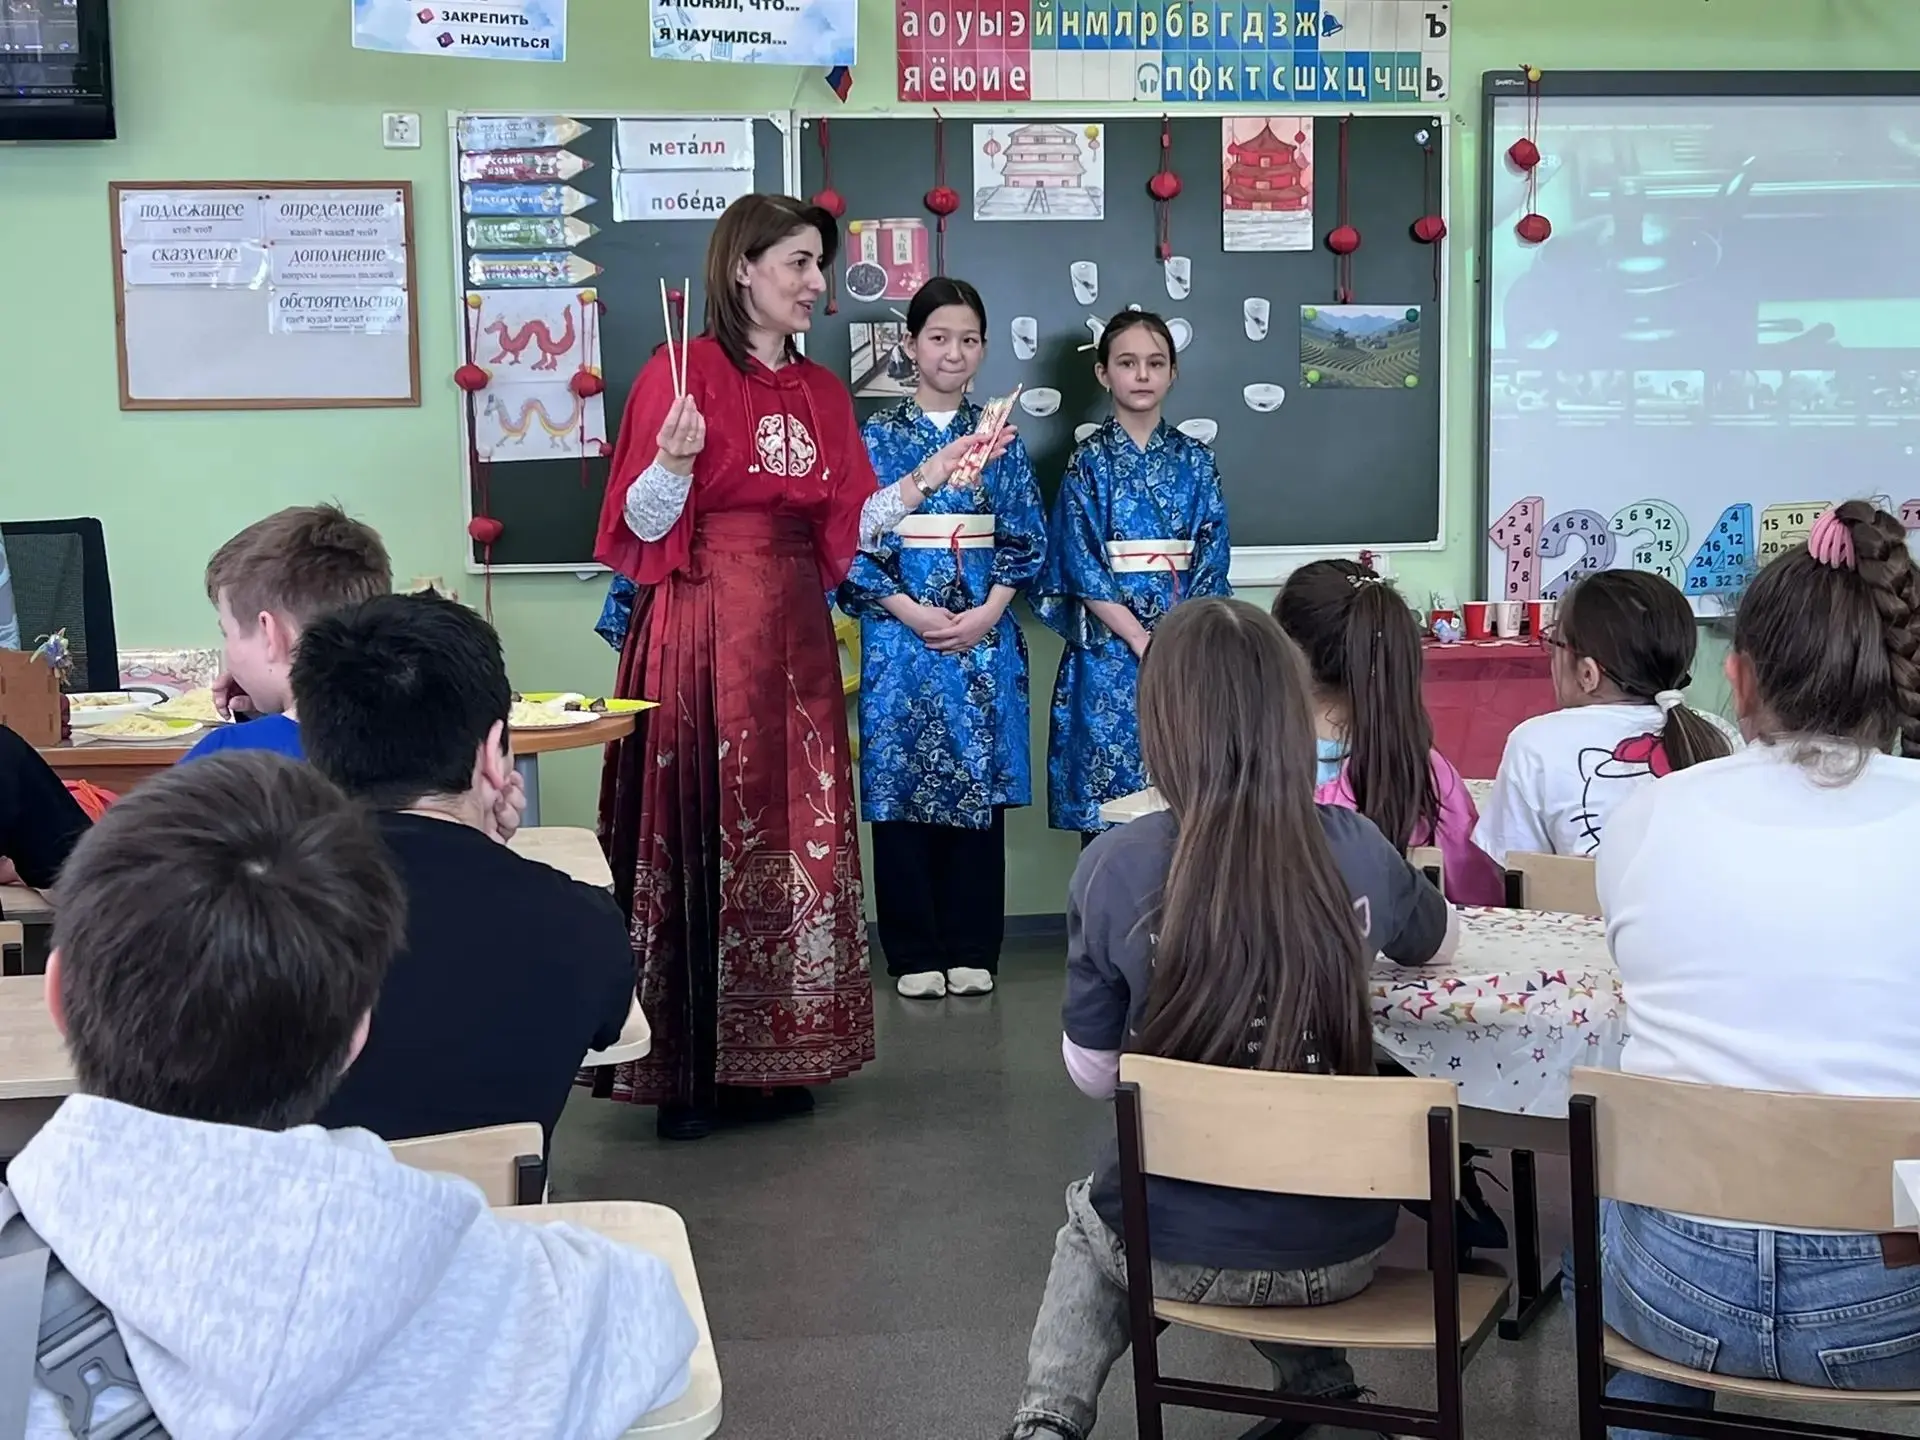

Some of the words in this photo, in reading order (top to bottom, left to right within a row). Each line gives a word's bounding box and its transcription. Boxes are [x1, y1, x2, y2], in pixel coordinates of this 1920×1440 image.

[441, 11, 529, 25] ЗАКРЕПИТЬ
[460, 34, 550, 49] НАУЧИТЬСЯ
[659, 28, 670, 39] Я
[677, 28, 787, 45] НАУЧИЛСЯ...
[484, 154, 523, 165] ССКИЙ
[140, 203, 244, 220] подлежащее
[280, 203, 384, 220] определение
[152, 248, 238, 264] сказуемое
[288, 249, 386, 267] дополнение
[280, 292, 403, 309] обстоятельство
[1520, 505, 1528, 516] 3
[1629, 510, 1637, 521] 6
[1645, 508, 1653, 519] 9
[1730, 510, 1739, 522] 4
[1508, 517, 1516, 527] 2
[1566, 517, 1574, 529] 6
[1581, 519, 1589, 530] 8
[1615, 519, 1623, 530] 3
[1655, 519, 1671, 530] 12
[1762, 519, 1779, 530] 15
[1788, 513, 1803, 525] 10
[1524, 523, 1532, 533] 4
[1552, 523, 1560, 534] 4
[1720, 522, 1728, 534] 8
[1497, 529, 1504, 540] 1
[1513, 535, 1521, 545] 5
[1590, 534, 1605, 545] 10
[1727, 534, 1743, 545] 12
[1541, 538, 1549, 549] 2
[1657, 541, 1673, 551] 15
[1705, 541, 1721, 552] 16
[1762, 542, 1778, 553] 20
[1523, 547, 1531, 558] 6
[1636, 552, 1652, 564] 18
[1581, 557, 1597, 568] 12
[1696, 556, 1712, 568] 24
[1727, 554, 1743, 565] 20
[1511, 561, 1519, 572] 7
[1522, 571, 1529, 582] 8
[1563, 571, 1577, 582] 14
[1715, 575, 1732, 587] 32
[1510, 583, 1518, 593] 9
[1691, 577, 1707, 588] 28
[1541, 591, 1557, 600] 16
